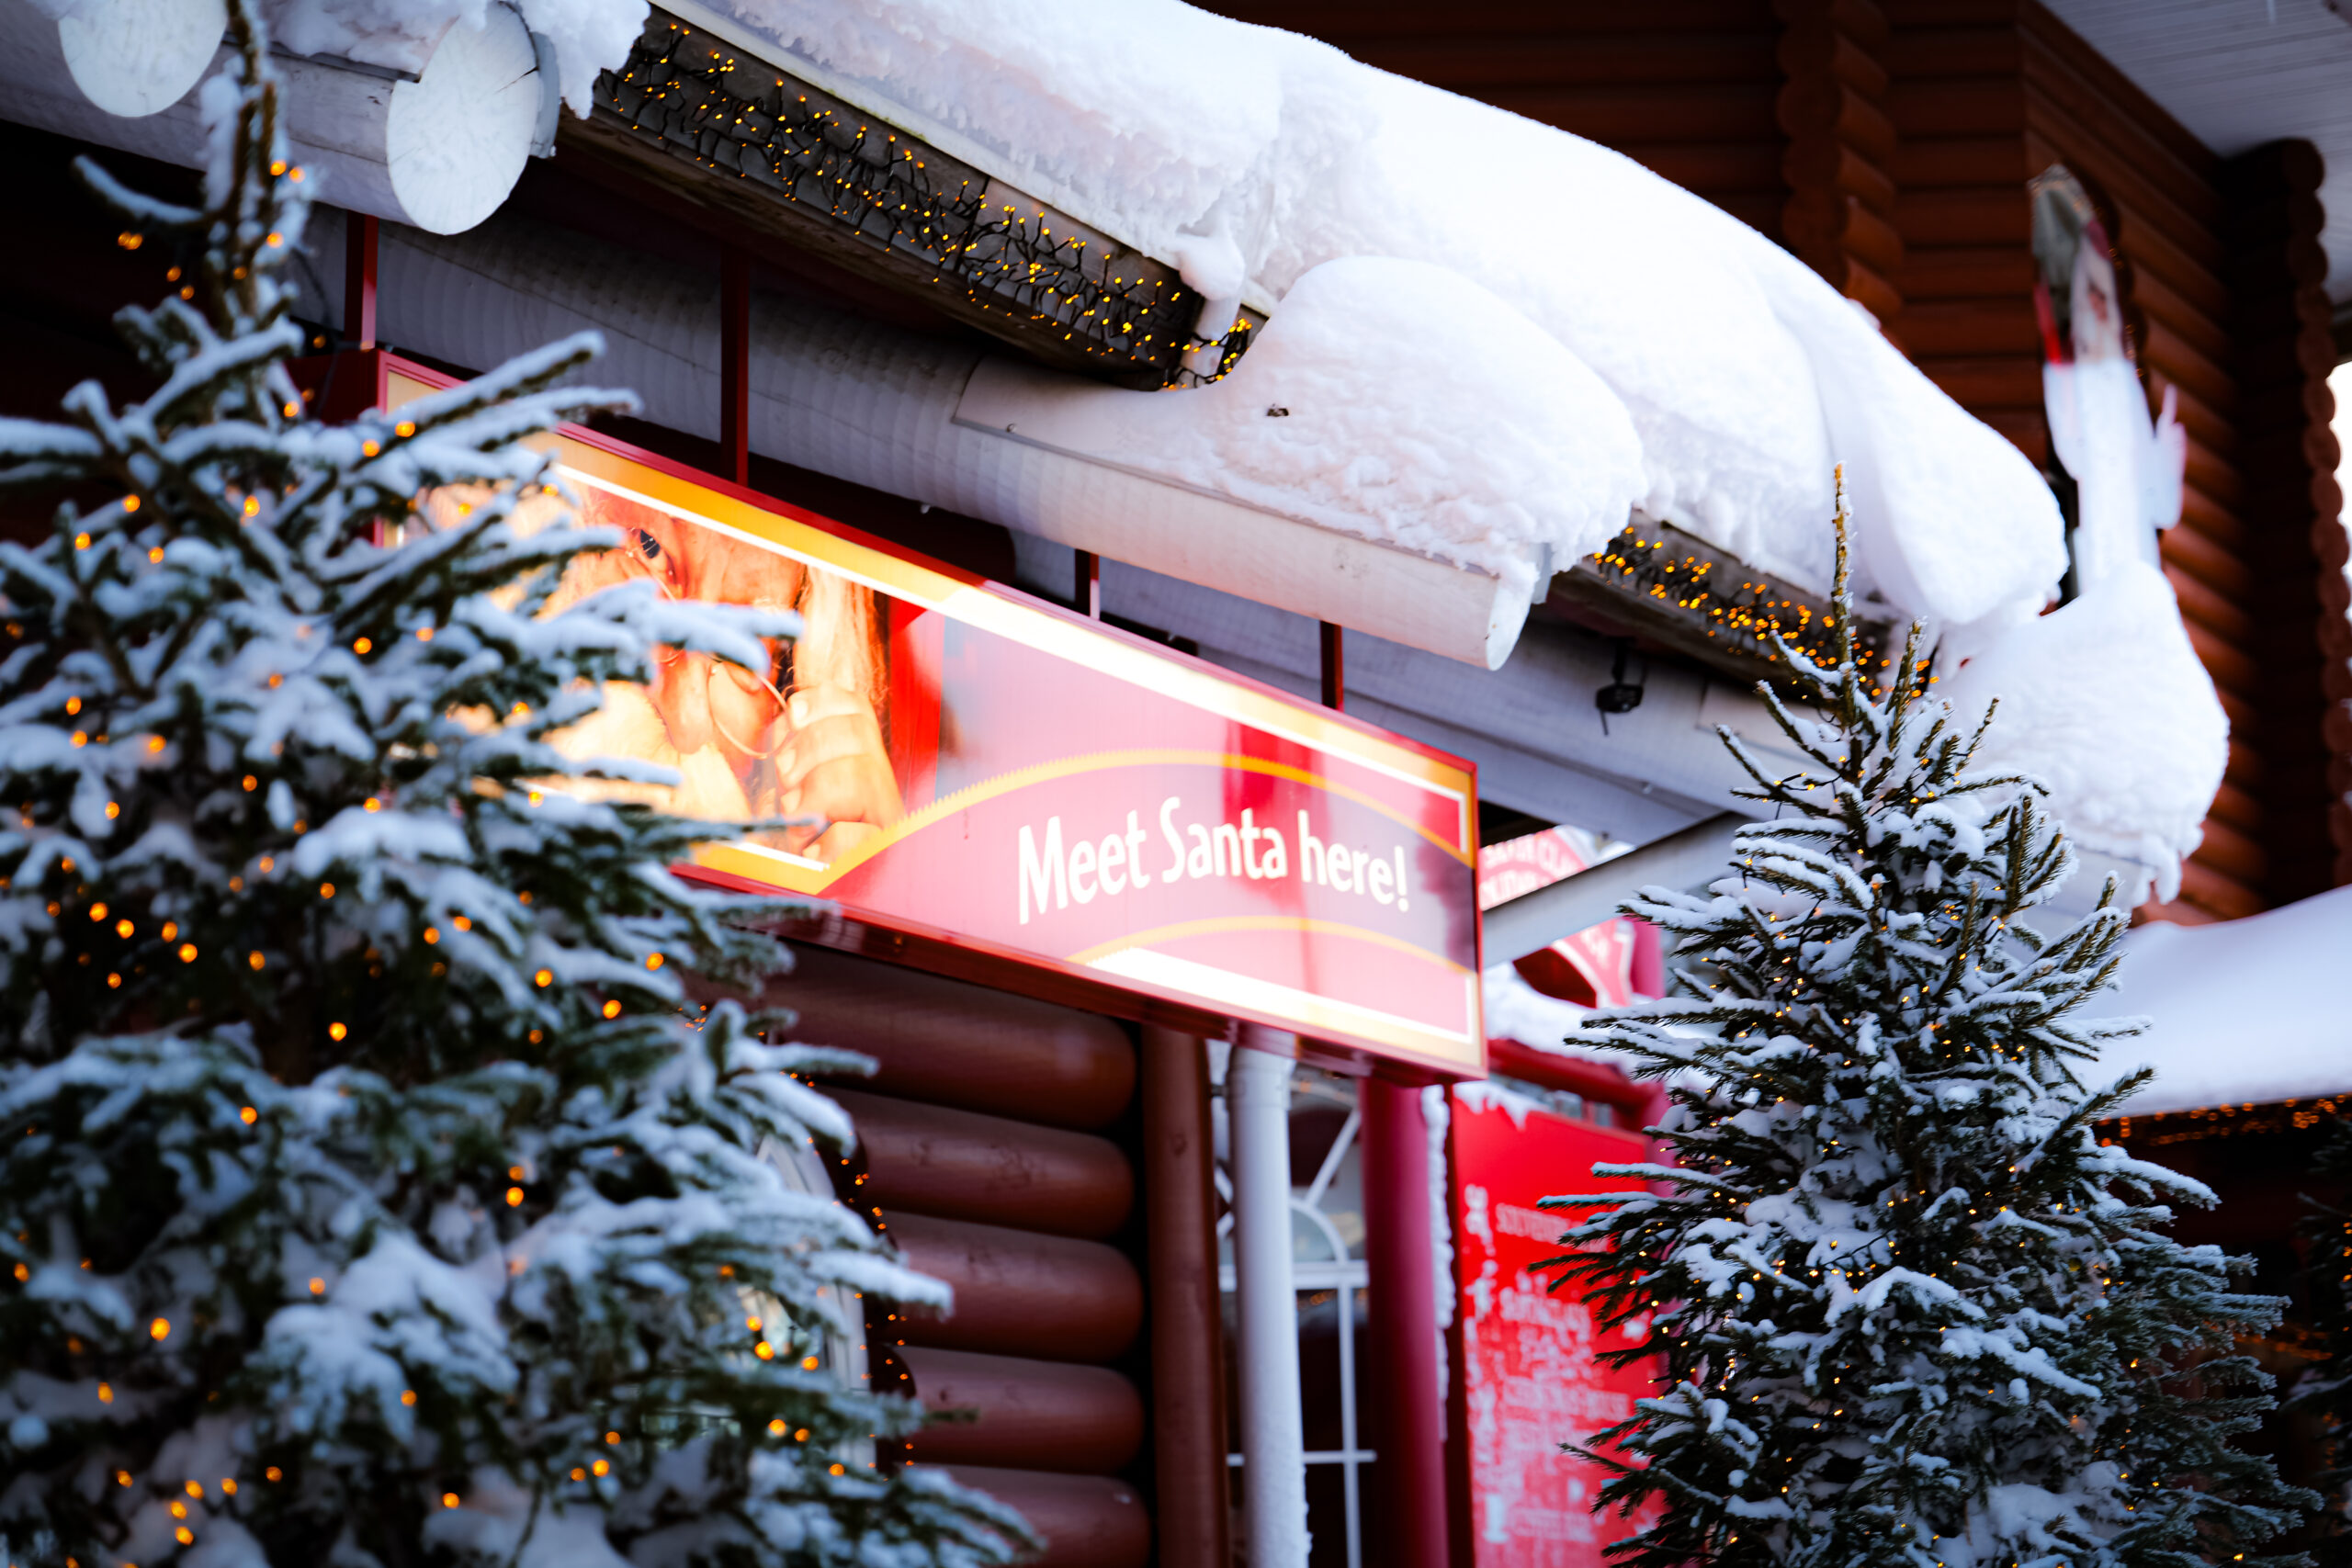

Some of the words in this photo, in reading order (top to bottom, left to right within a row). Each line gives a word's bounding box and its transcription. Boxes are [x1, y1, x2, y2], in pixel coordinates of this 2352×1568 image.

[1018, 809, 1150, 925] Meet
[1159, 795, 1288, 884] Santa
[1297, 809, 1409, 913] here!
